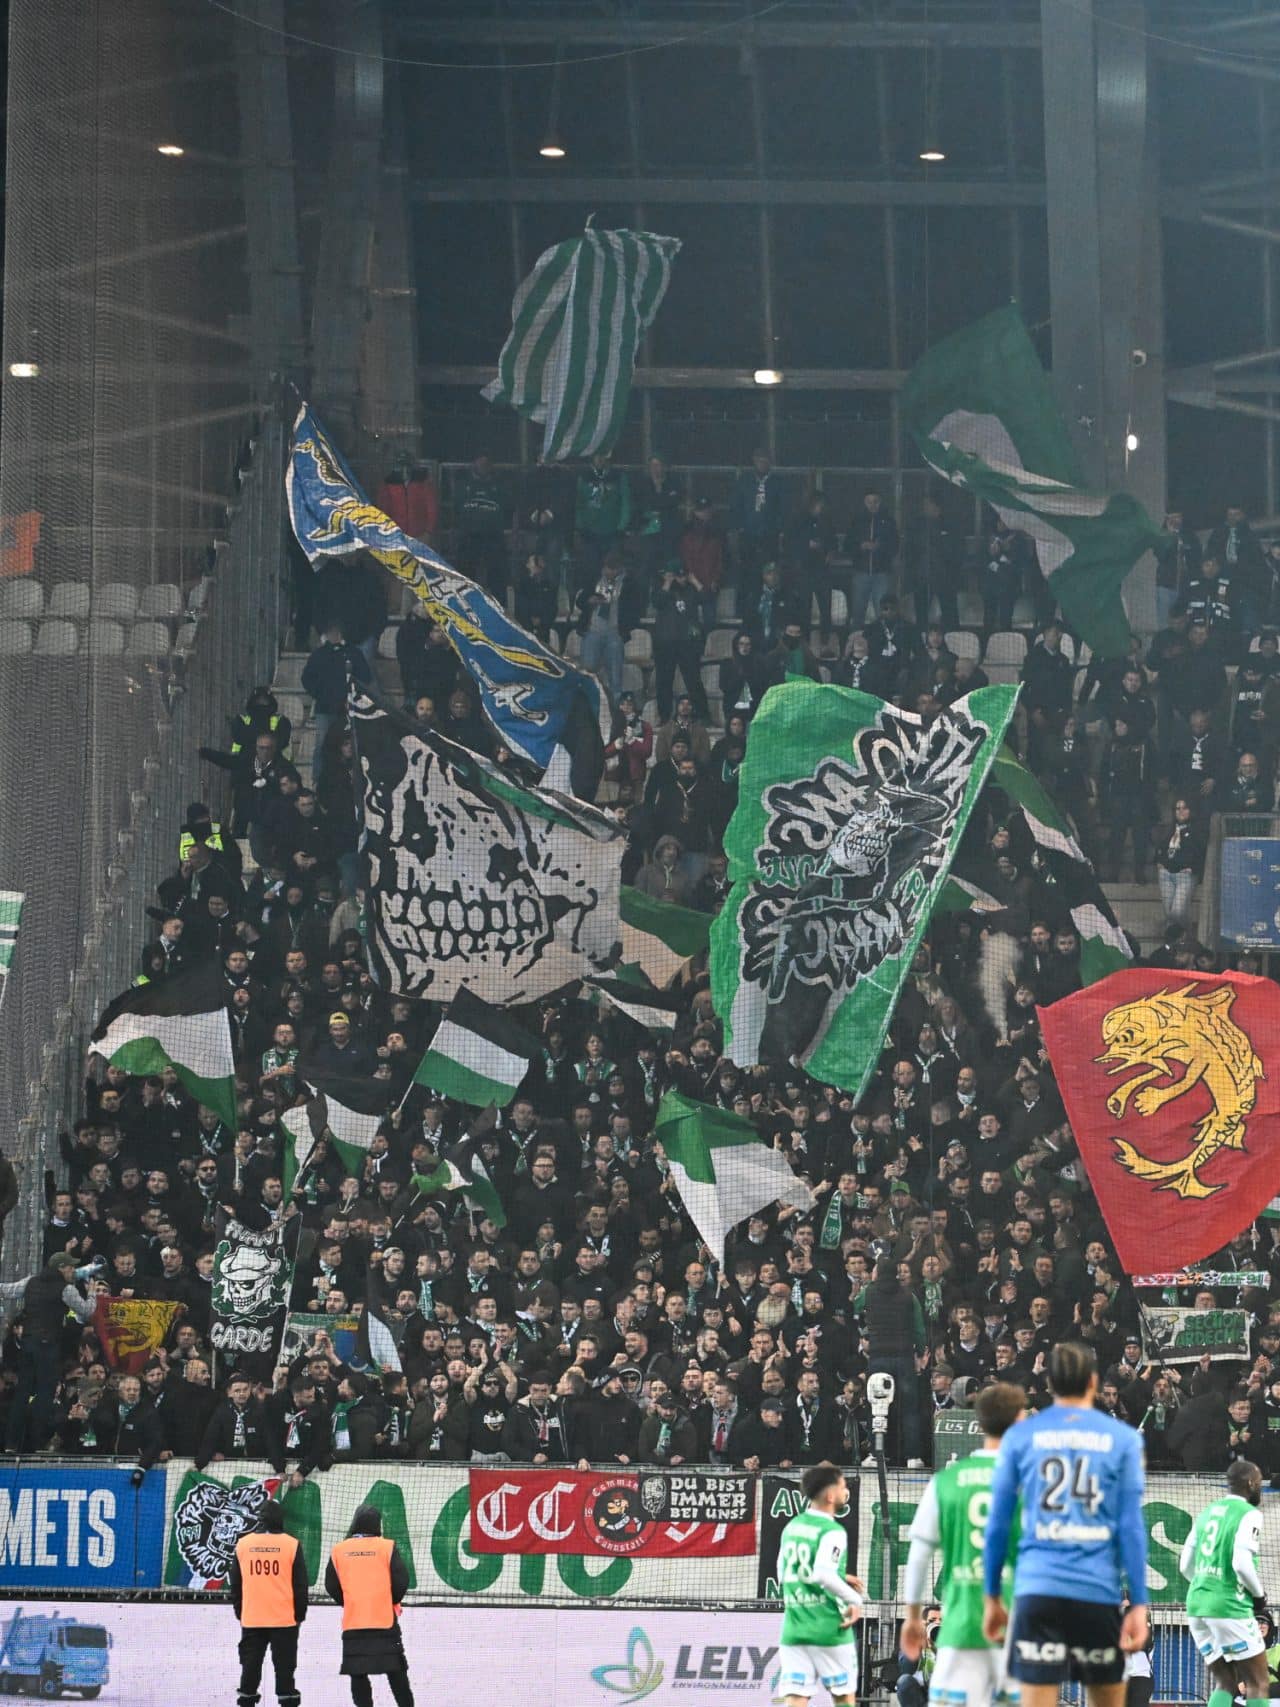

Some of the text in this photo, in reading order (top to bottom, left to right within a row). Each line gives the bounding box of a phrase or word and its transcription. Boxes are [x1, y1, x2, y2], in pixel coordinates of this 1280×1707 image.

[1184, 1311, 1246, 1332] SECTION
[210, 1322, 274, 1352] GARDE
[671, 1478, 748, 1492] DU BIST
[1041, 1456, 1103, 1514] 24
[671, 1492, 746, 1507] IMMER
[670, 1507, 744, 1520] BEI UNS!
[1201, 1519, 1219, 1556] 3
[250, 1559, 280, 1576] 1090
[782, 1541, 813, 1584] 28
[674, 1645, 779, 1681] LELY
[671, 1681, 762, 1690] ENVIRONNEMENT
